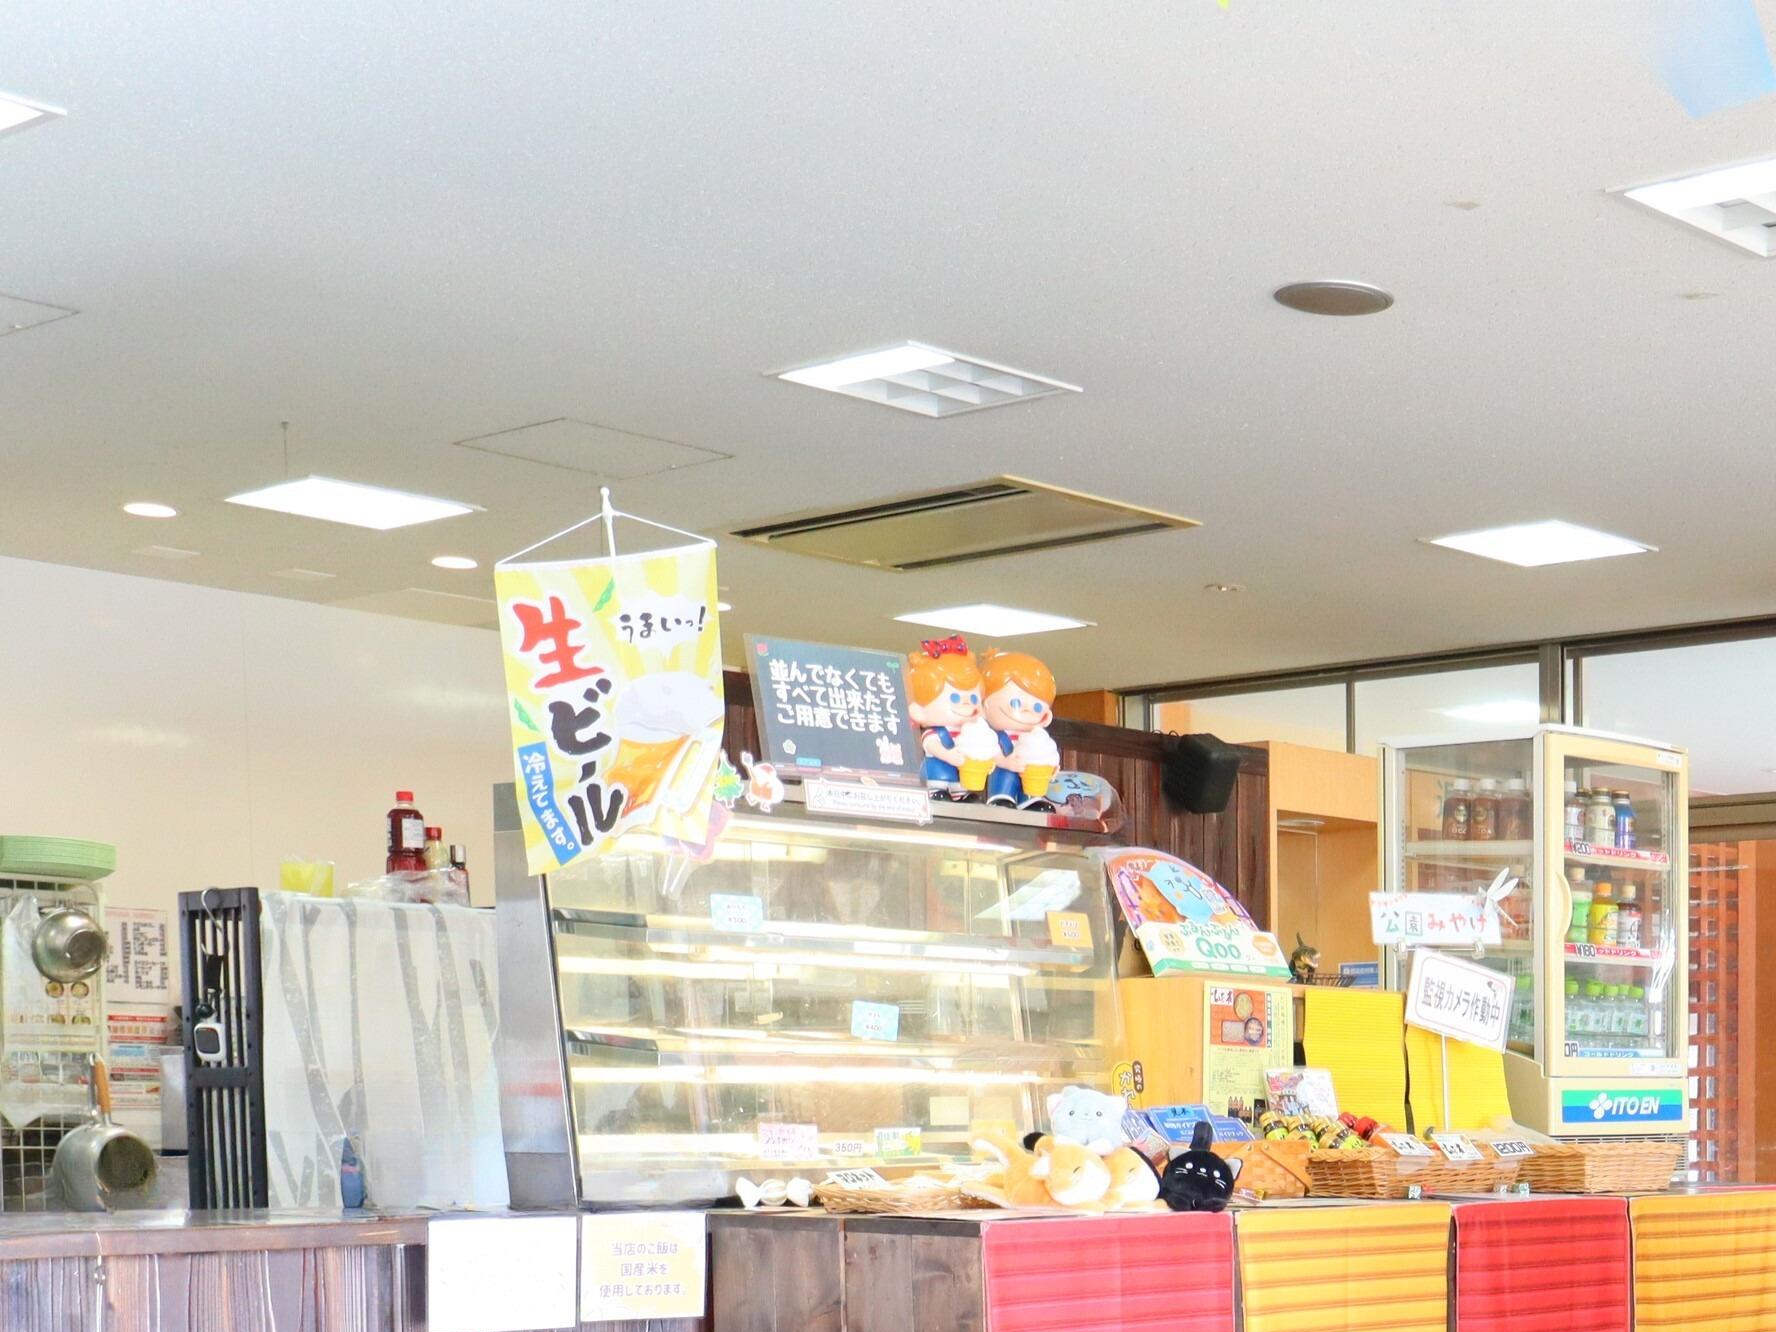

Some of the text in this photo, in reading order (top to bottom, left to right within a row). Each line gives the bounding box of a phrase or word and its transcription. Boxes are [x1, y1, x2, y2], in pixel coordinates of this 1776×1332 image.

[769, 659, 895, 694] 並んでなくても
[772, 683, 898, 715] すべて出来たて
[512, 595, 626, 846] 生ビール
[777, 701, 900, 735] ご用意できます
[522, 753, 575, 852] 冷えてます。
[1196, 937, 1242, 960] Qoo
[1422, 976, 1501, 1028] 監視カメラ作動中
[1611, 1096, 1661, 1115] ITO EN
[835, 1142, 862, 1153] 350円
[1494, 1141, 1531, 1154] 1200円
[611, 1241, 679, 1257] 当店のご飯は
[620, 1263, 669, 1278] 国産米を
[599, 1283, 687, 1299] 使用しております。
